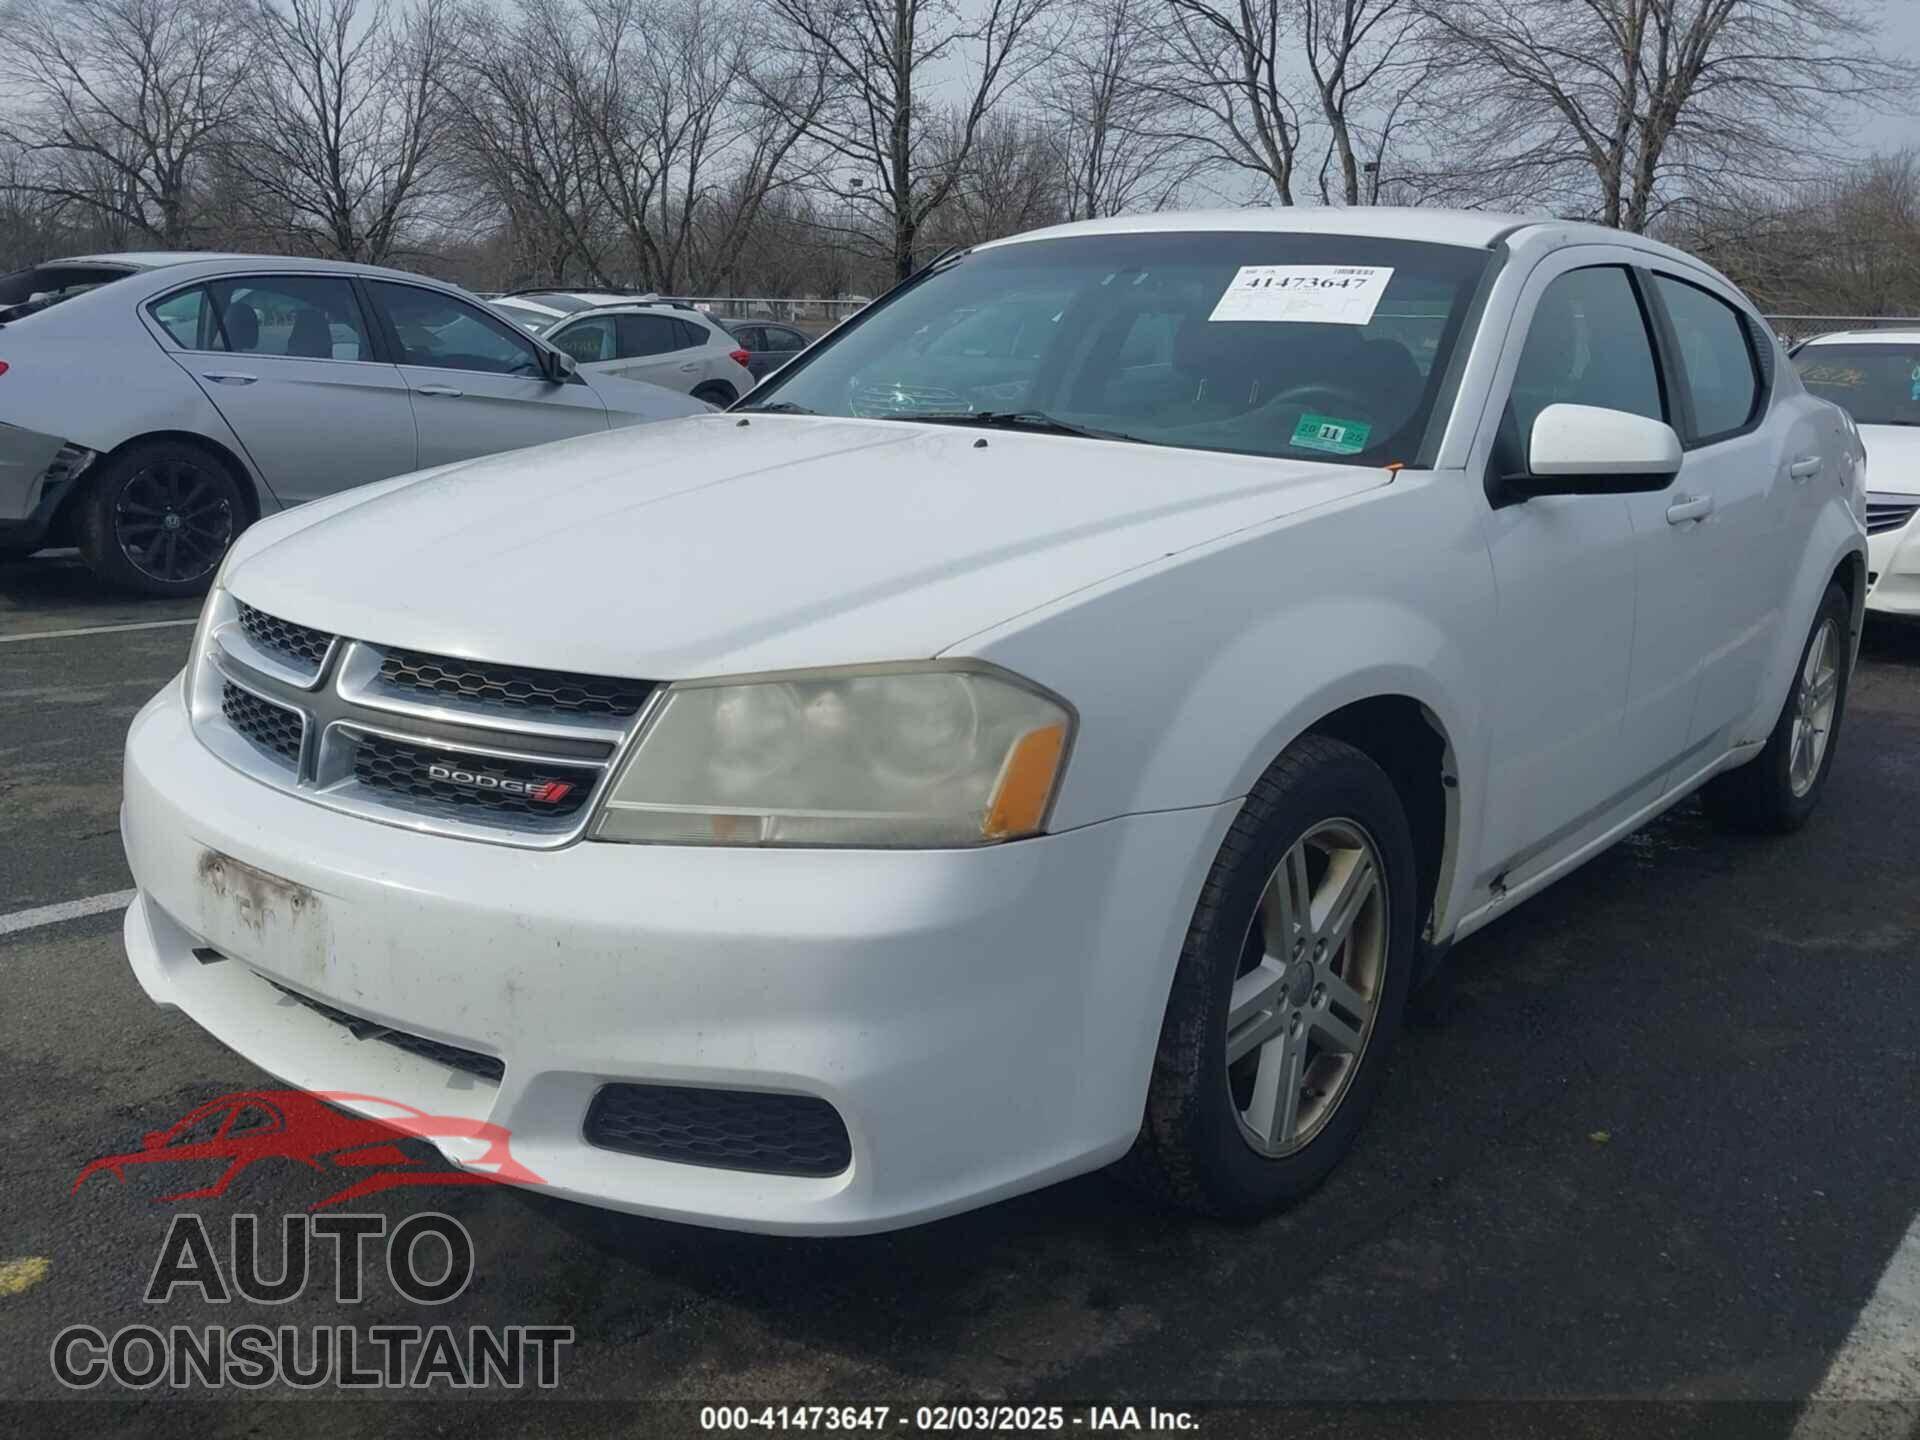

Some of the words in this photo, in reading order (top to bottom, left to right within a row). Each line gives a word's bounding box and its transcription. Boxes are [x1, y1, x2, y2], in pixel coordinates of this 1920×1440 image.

[1246, 277, 1367, 289] 41473647
[1321, 426, 1339, 440] 11
[429, 765, 546, 795] DODGE
